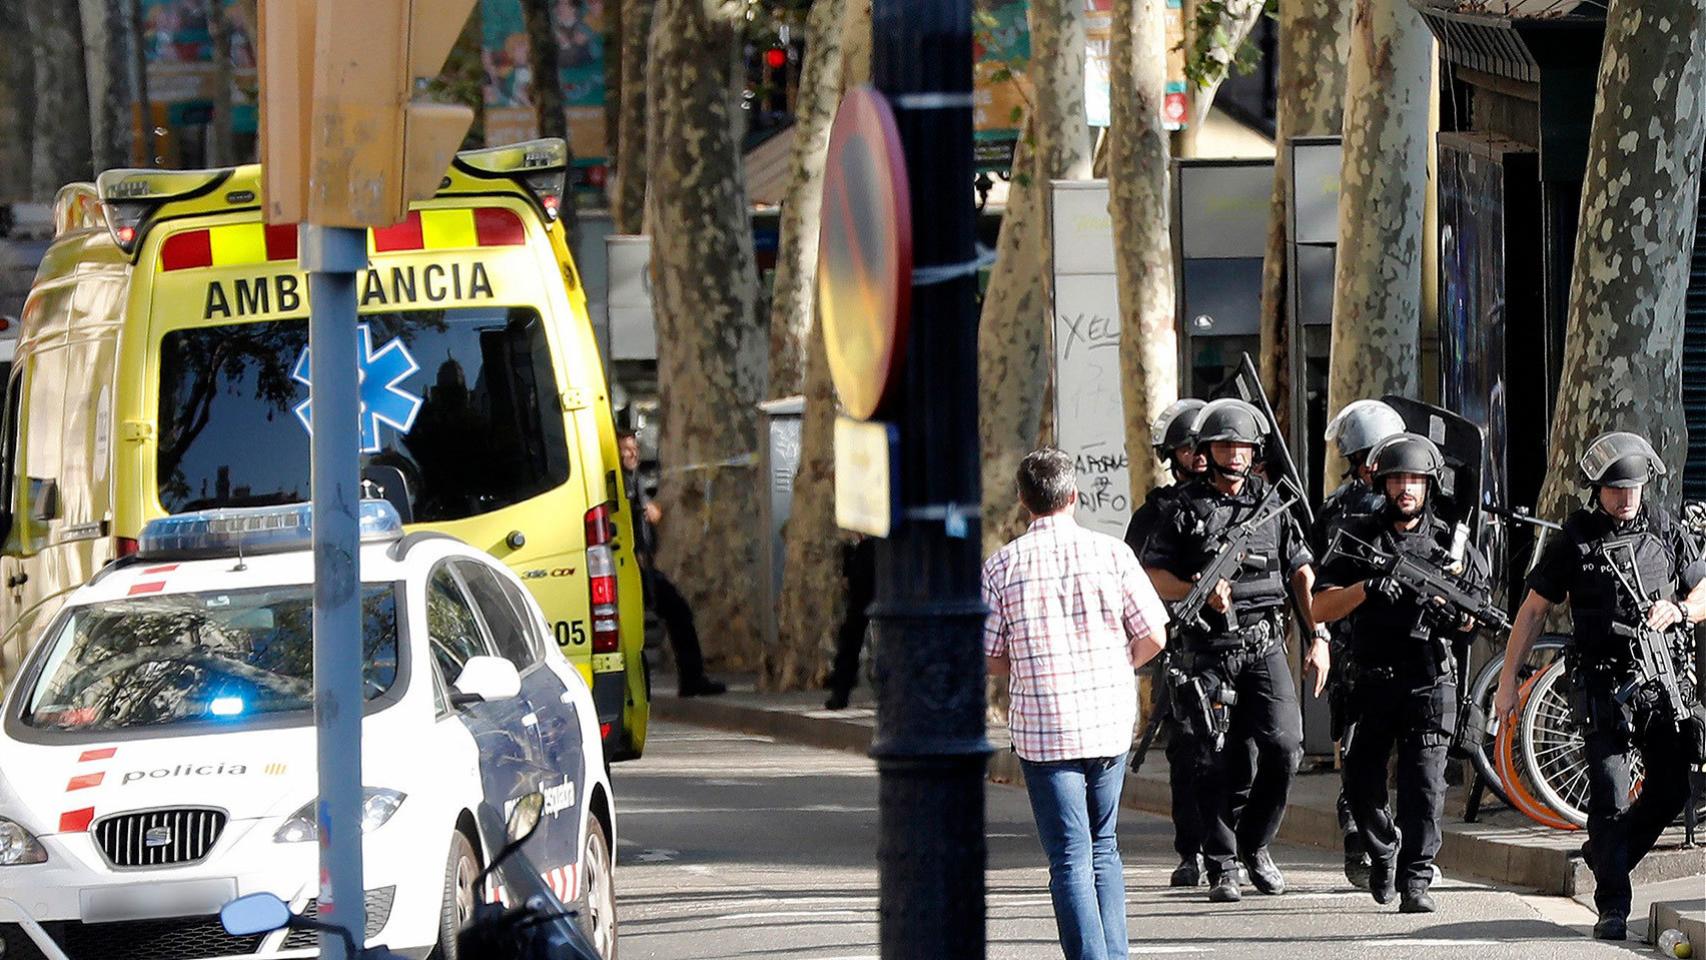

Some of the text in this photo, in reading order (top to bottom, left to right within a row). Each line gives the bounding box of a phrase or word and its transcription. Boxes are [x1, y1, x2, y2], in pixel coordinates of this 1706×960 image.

[203, 260, 494, 320] AMBÀNCIA
[550, 567, 576, 578] CDI
[547, 620, 586, 648] 05
[121, 762, 248, 786] policia
